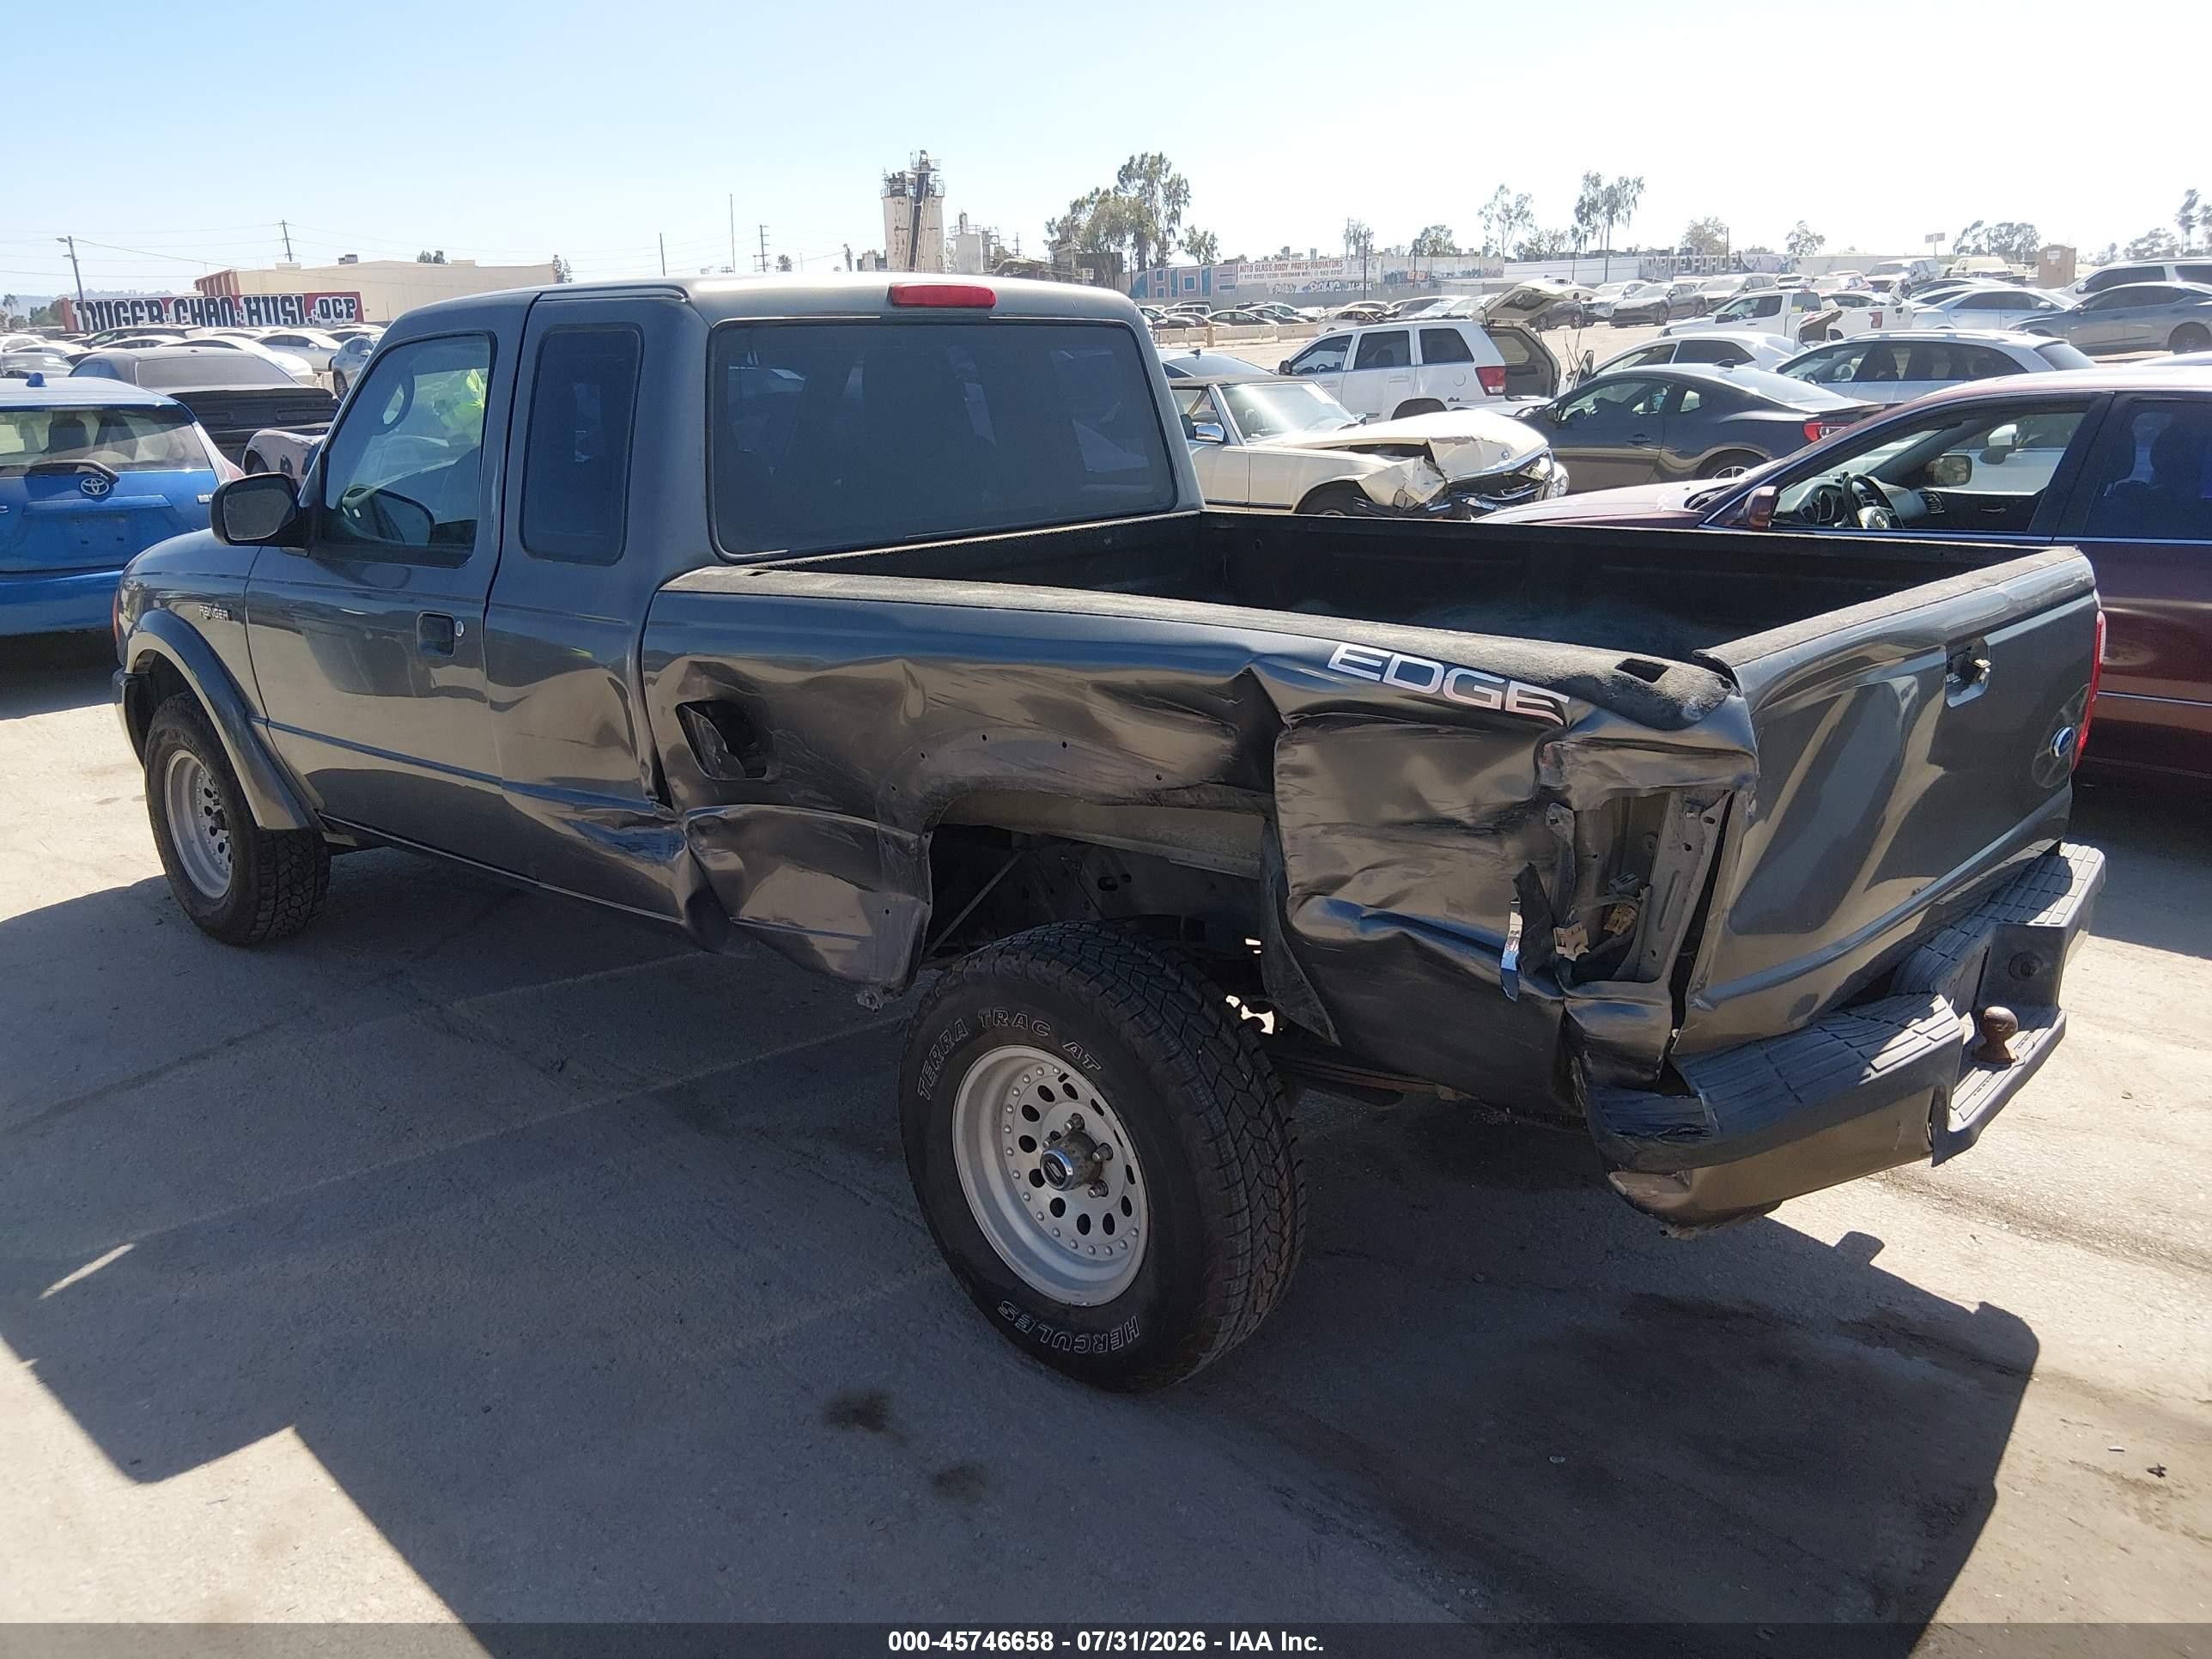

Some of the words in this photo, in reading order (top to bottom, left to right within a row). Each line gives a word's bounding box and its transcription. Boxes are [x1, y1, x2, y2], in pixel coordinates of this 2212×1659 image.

[1239, 264, 1254, 273] AUTO
[1255, 264, 1273, 272] GLASS
[1274, 263, 1289, 271] BODY
[1291, 262, 1308, 270] PARTS
[1310, 259, 1344, 270] RADIATORS
[198, 605, 228, 621] RANGER
[1327, 642, 1571, 726] EDGE
[916, 1018, 968, 1101] TERRA
[977, 1008, 1051, 1038] TRAC
[1061, 1040, 1103, 1073] AT
[998, 1297, 1141, 1354] HERCULES
